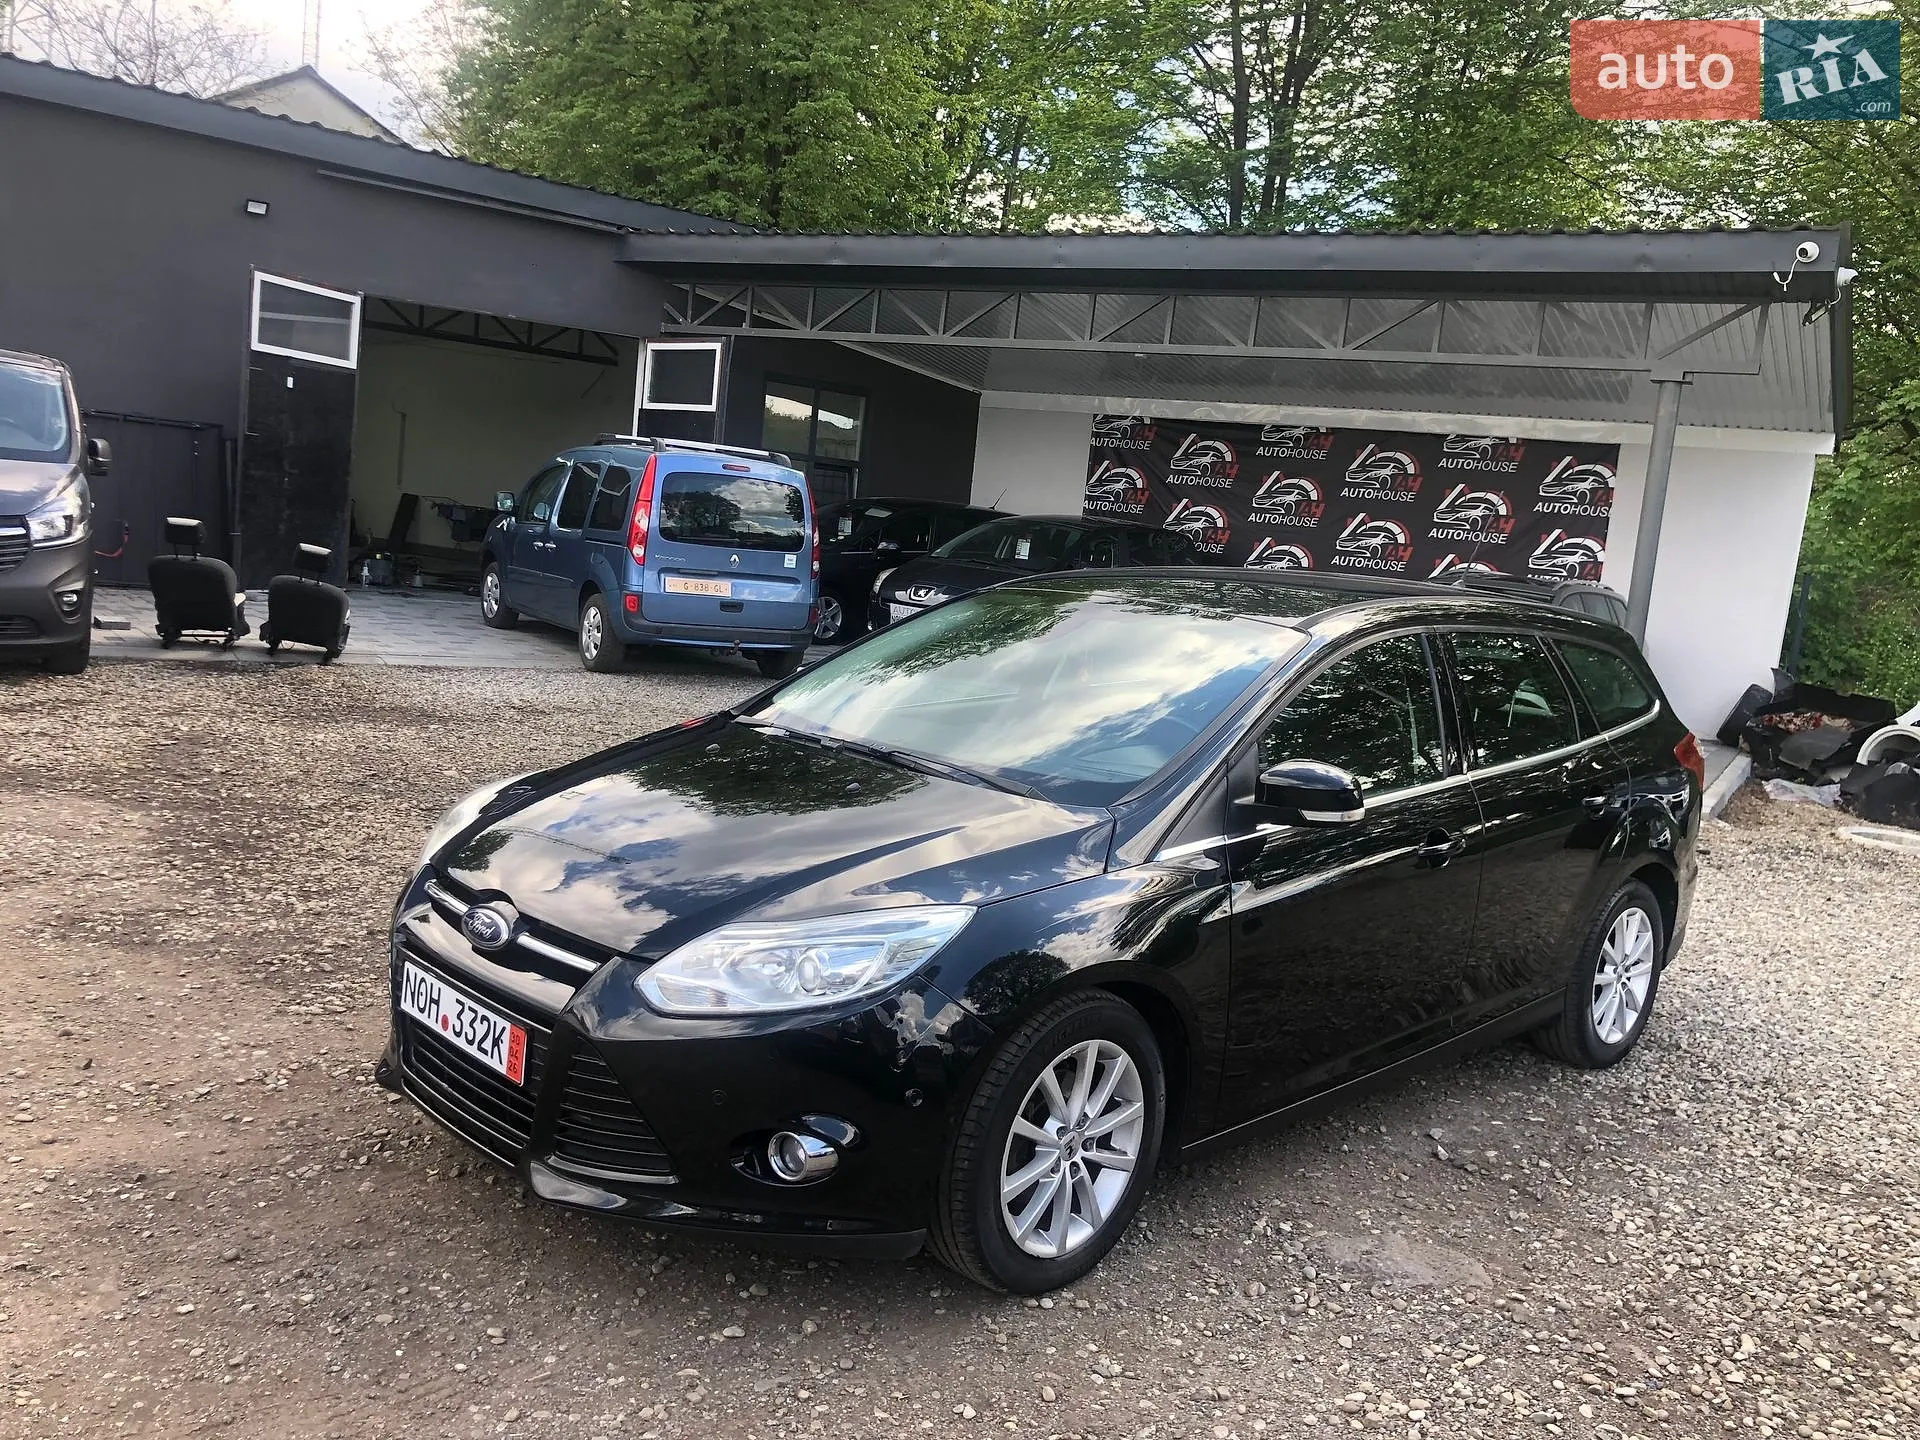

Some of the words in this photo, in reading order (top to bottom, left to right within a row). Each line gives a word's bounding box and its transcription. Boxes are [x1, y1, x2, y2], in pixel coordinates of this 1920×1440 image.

[1089, 437, 1152, 450] AUTOHOUSE
[1255, 446, 1328, 460] AUTOHOUSE
[1438, 457, 1519, 473] AUTOHOUSE
[1166, 474, 1234, 489] AUTOHOUSE
[1340, 487, 1417, 502] AUTOHOUSE
[1082, 500, 1145, 514] AUTOHOUSE
[1533, 501, 1609, 518] AUTOHOUS
[1248, 512, 1320, 528] AUTOHOUSE
[1428, 528, 1509, 545] AUTOHOUSE
[1331, 555, 1407, 572] AUTOHOUSE
[469, 912, 496, 939] Ford
[453, 998, 507, 1065] 332K
